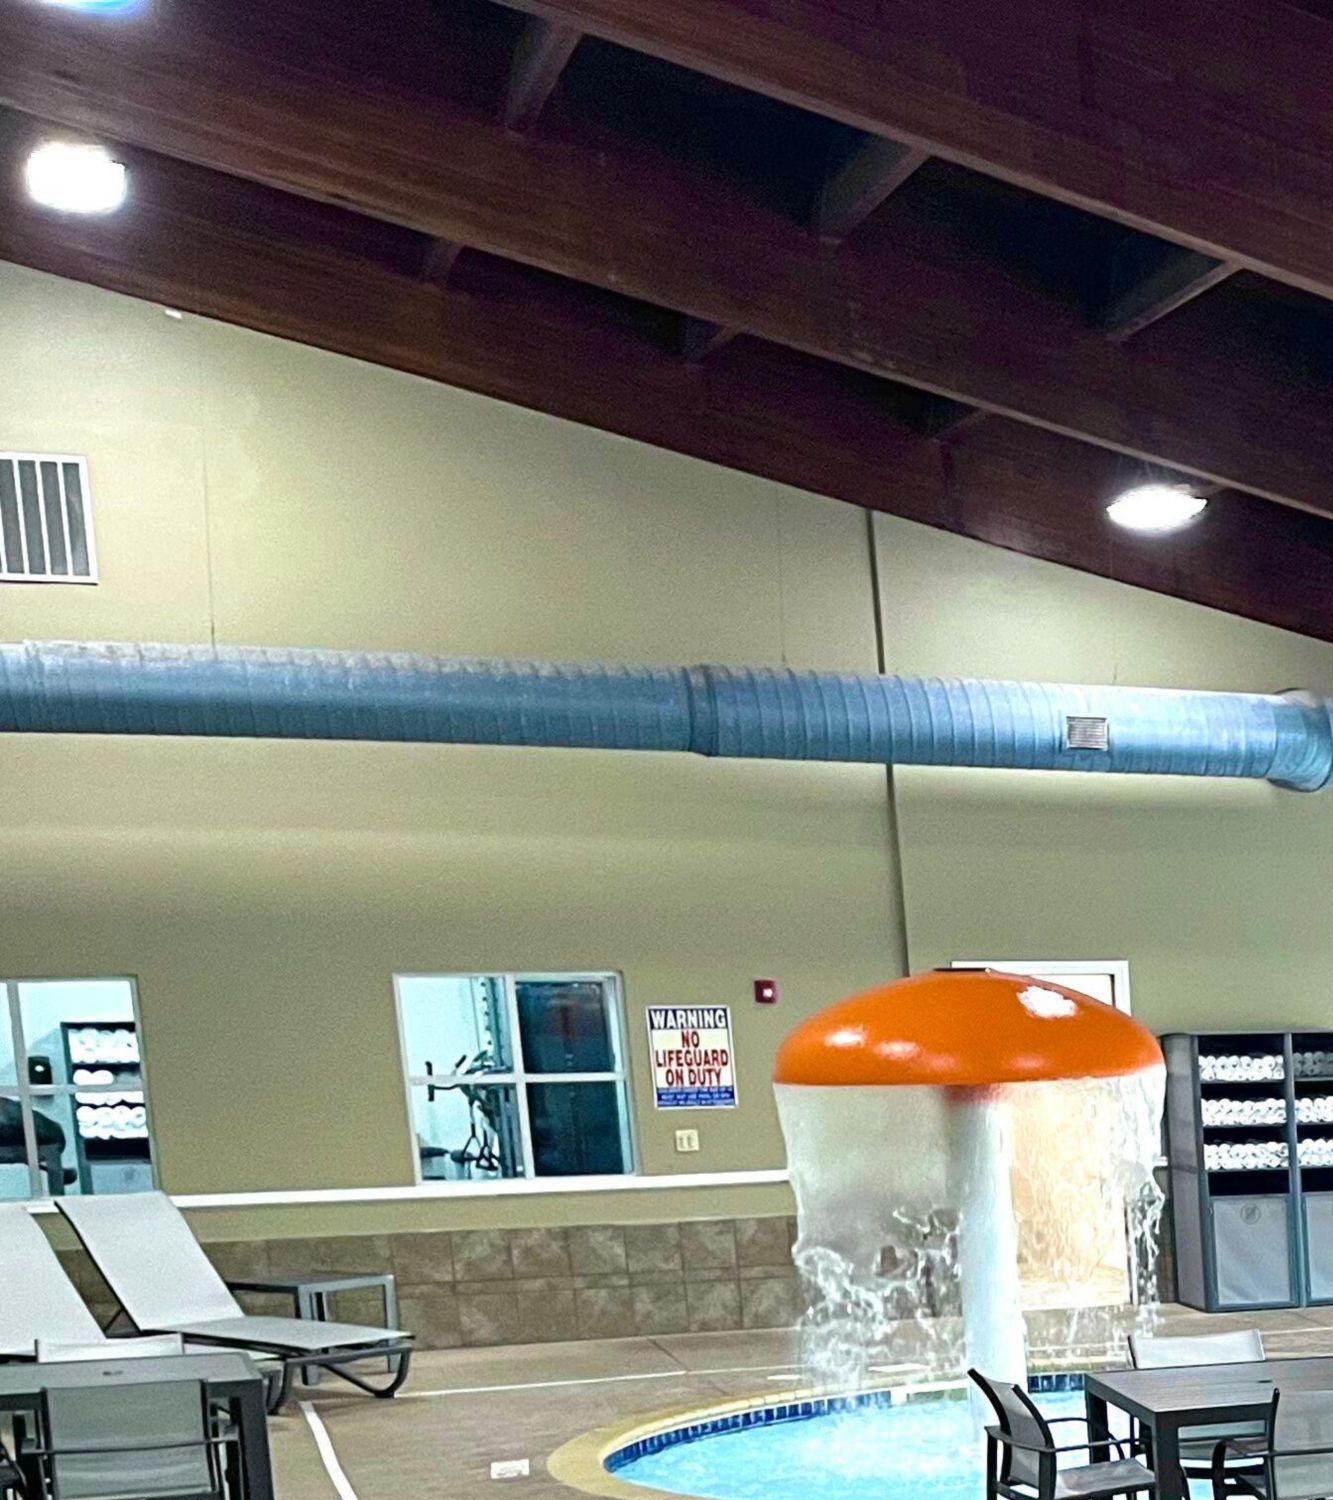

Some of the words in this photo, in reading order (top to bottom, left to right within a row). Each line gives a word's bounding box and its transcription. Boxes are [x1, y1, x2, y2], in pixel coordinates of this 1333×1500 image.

[650, 1009, 726, 1029] WARNING
[681, 1031, 700, 1048] NO
[656, 1049, 729, 1067] LIFEGUARD
[666, 1069, 684, 1087] ON
[688, 1068, 721, 1087] DUTY
